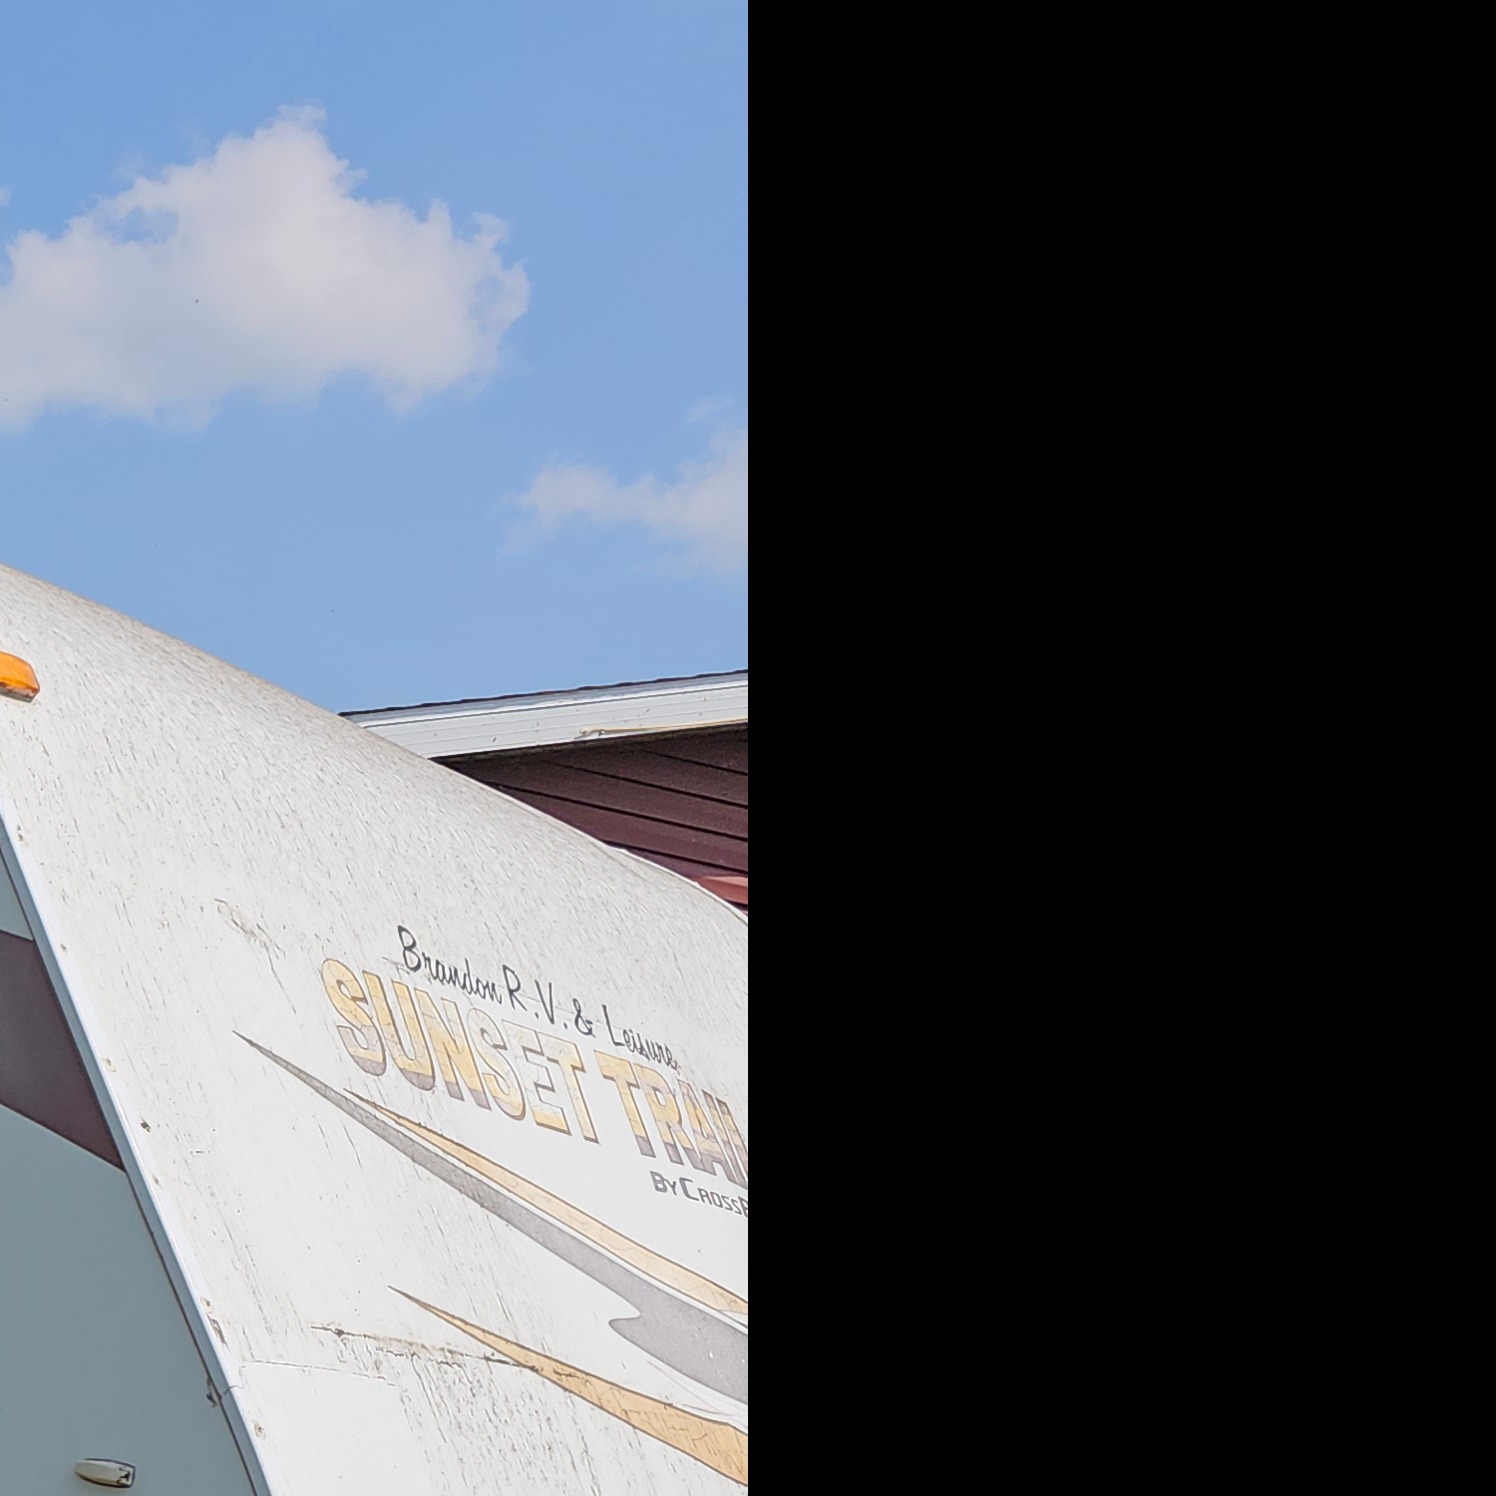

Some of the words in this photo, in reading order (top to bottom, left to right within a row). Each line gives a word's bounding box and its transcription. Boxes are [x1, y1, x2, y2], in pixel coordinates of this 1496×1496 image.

[320, 957, 600, 1145] SUNSET
[397, 924, 503, 1005] Brandon
[571, 997, 596, 1038] &
